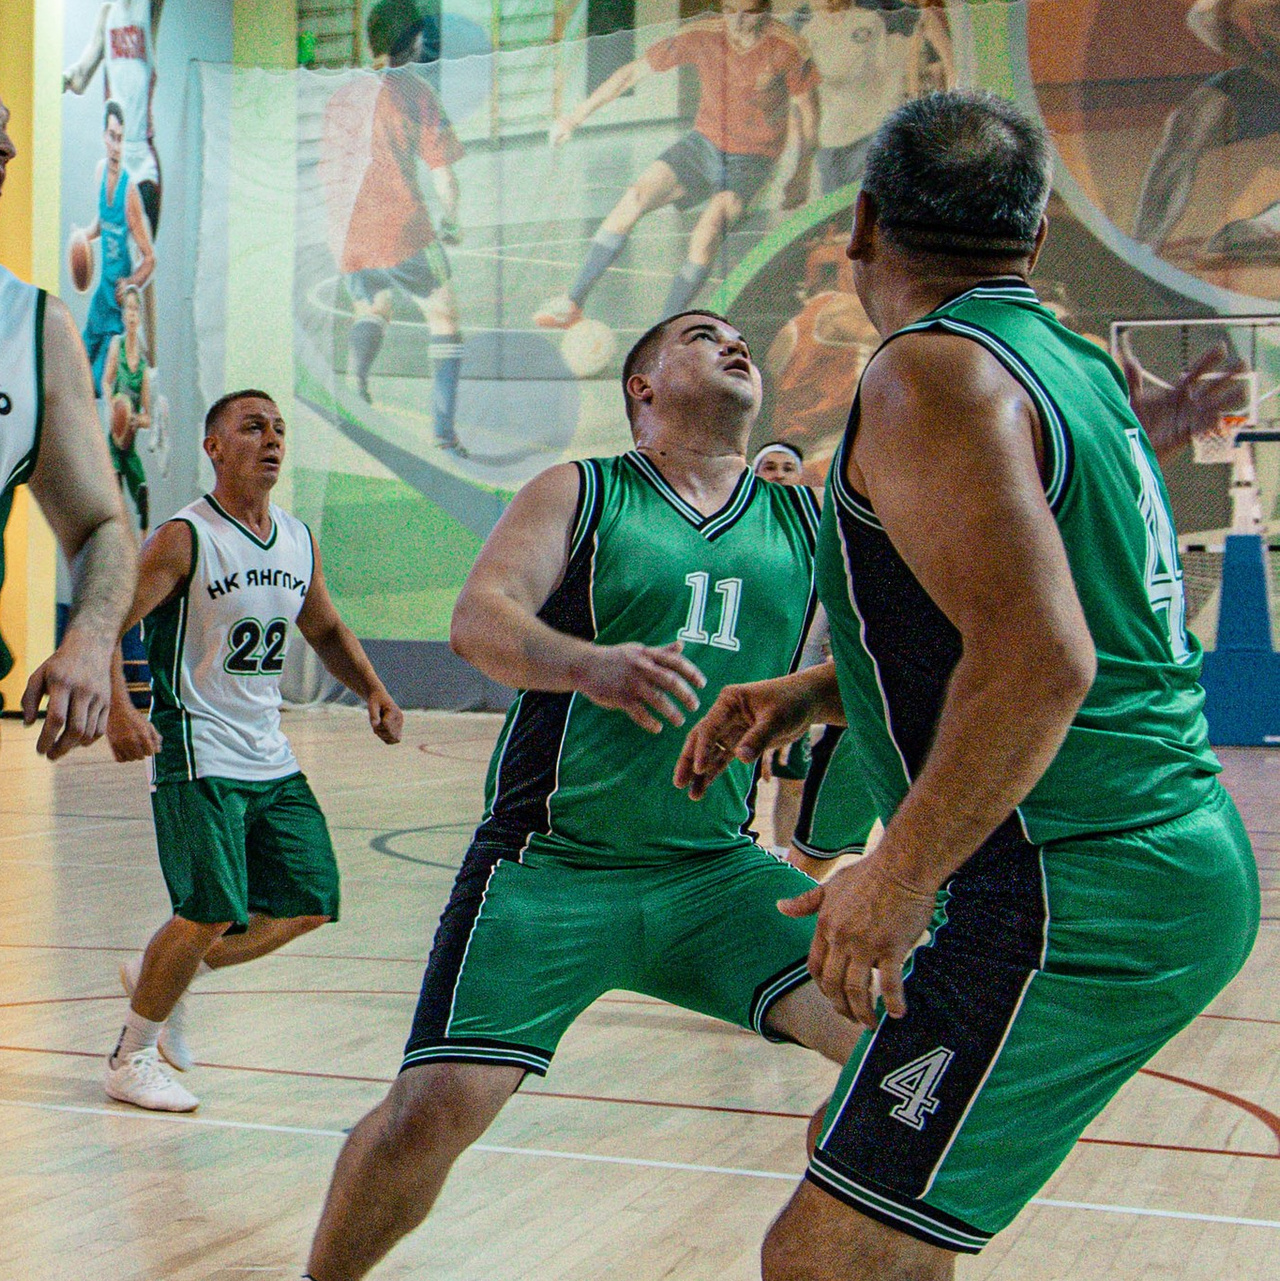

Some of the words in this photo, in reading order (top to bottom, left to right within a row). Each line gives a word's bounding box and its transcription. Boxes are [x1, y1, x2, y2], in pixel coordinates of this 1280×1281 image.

[207, 572, 241, 600] НК
[677, 571, 743, 652] 11
[223, 617, 289, 676] 22
[880, 1046, 955, 1131] 4
